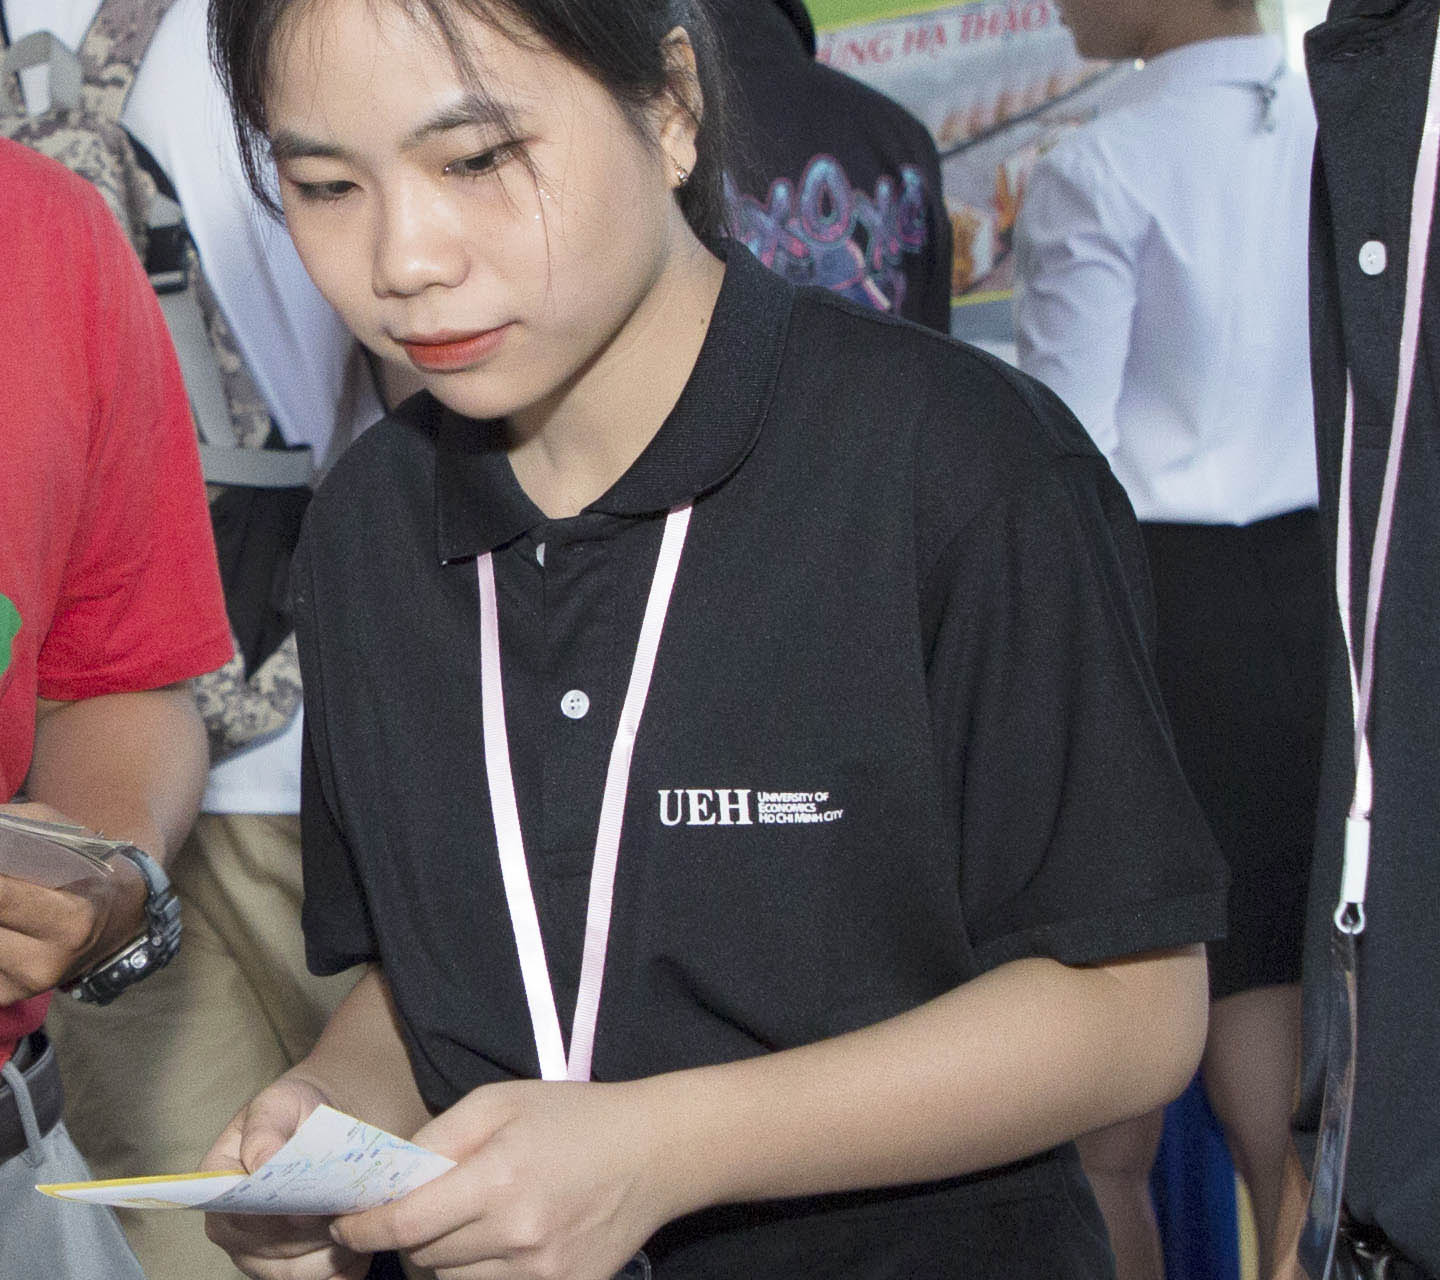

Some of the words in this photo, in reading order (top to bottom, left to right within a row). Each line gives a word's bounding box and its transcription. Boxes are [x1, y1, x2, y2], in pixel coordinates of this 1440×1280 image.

[757, 792, 813, 802] UNIVERSITY
[814, 791, 829, 802] OF
[658, 789, 753, 826] UEH
[758, 803, 816, 813] ECONOMICS
[794, 813, 823, 824] MINH
[823, 808, 844, 822] CITY
